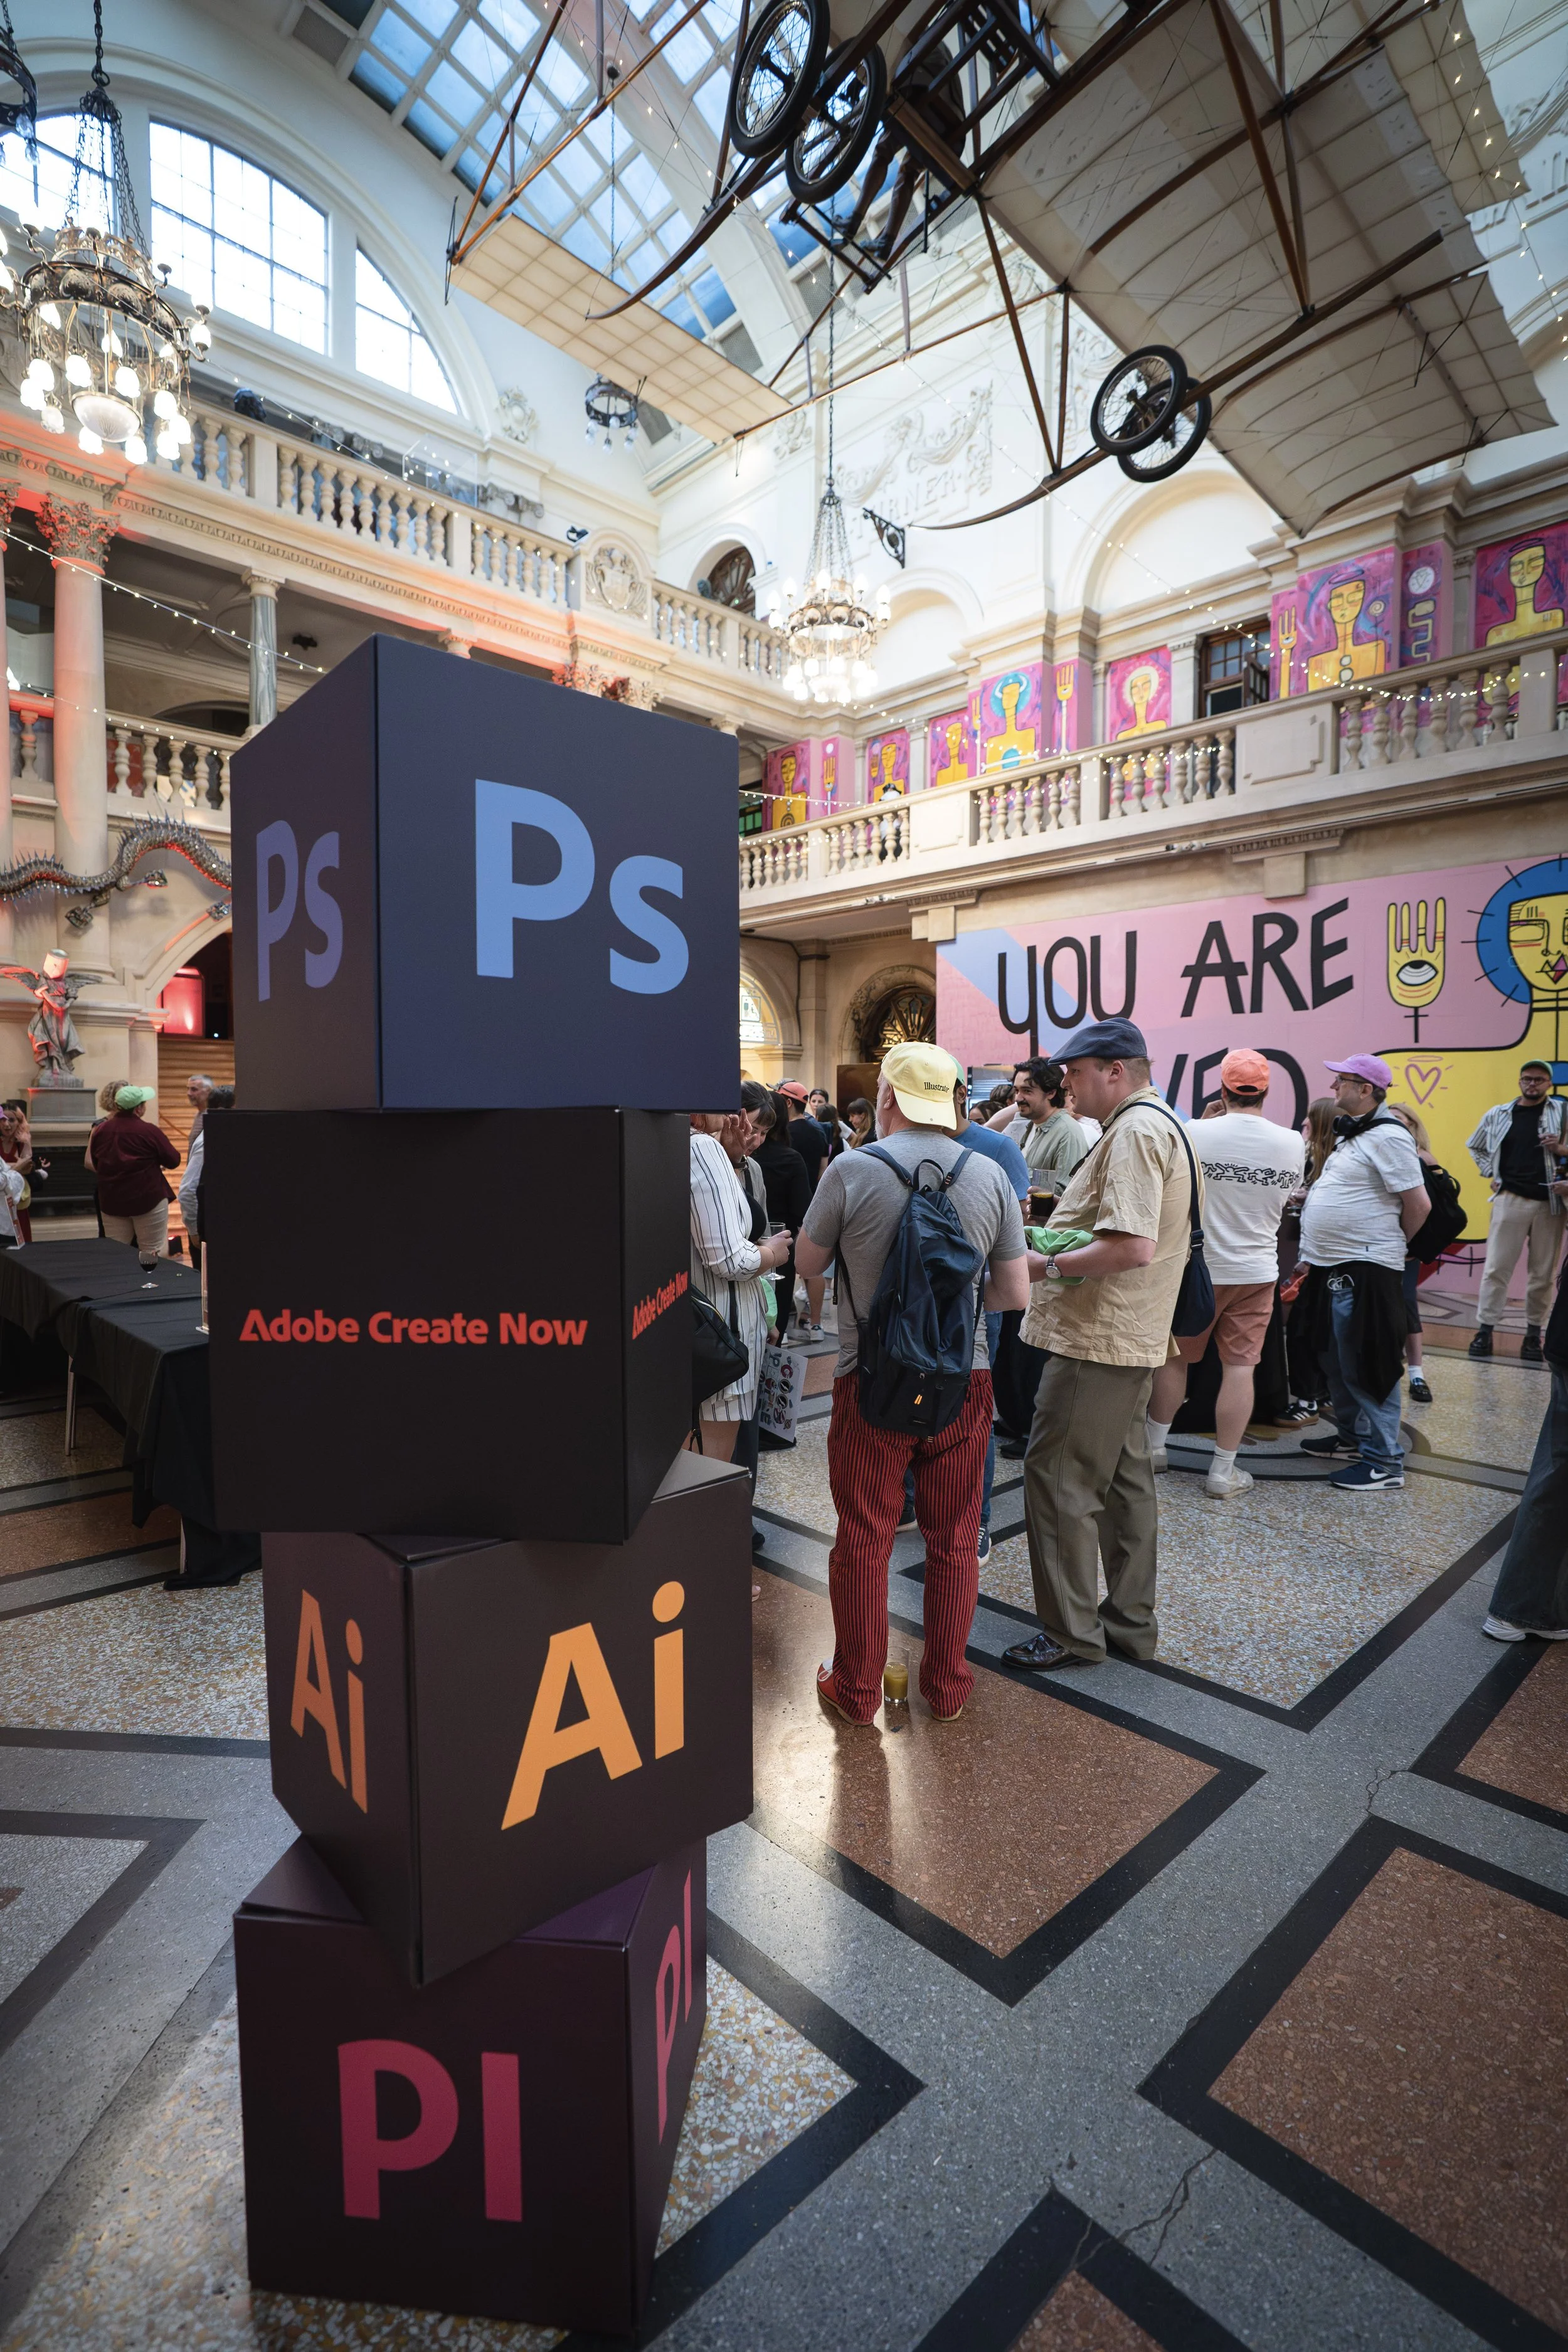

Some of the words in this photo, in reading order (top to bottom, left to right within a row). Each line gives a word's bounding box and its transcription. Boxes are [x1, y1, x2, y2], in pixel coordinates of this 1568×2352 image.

[256, 820, 343, 1002] Ps
[475, 778, 689, 995] Ps
[1180, 897, 1353, 1017] ARE
[240, 1309, 359, 1343] Adobe
[369, 1311, 489, 1345] Create
[499, 1313, 588, 1345] Now
[632, 1295, 656, 1340] Adobe
[656, 1278, 675, 1316] Create
[291, 1589, 368, 1814] Ai
[501, 1581, 686, 1830] Ai
